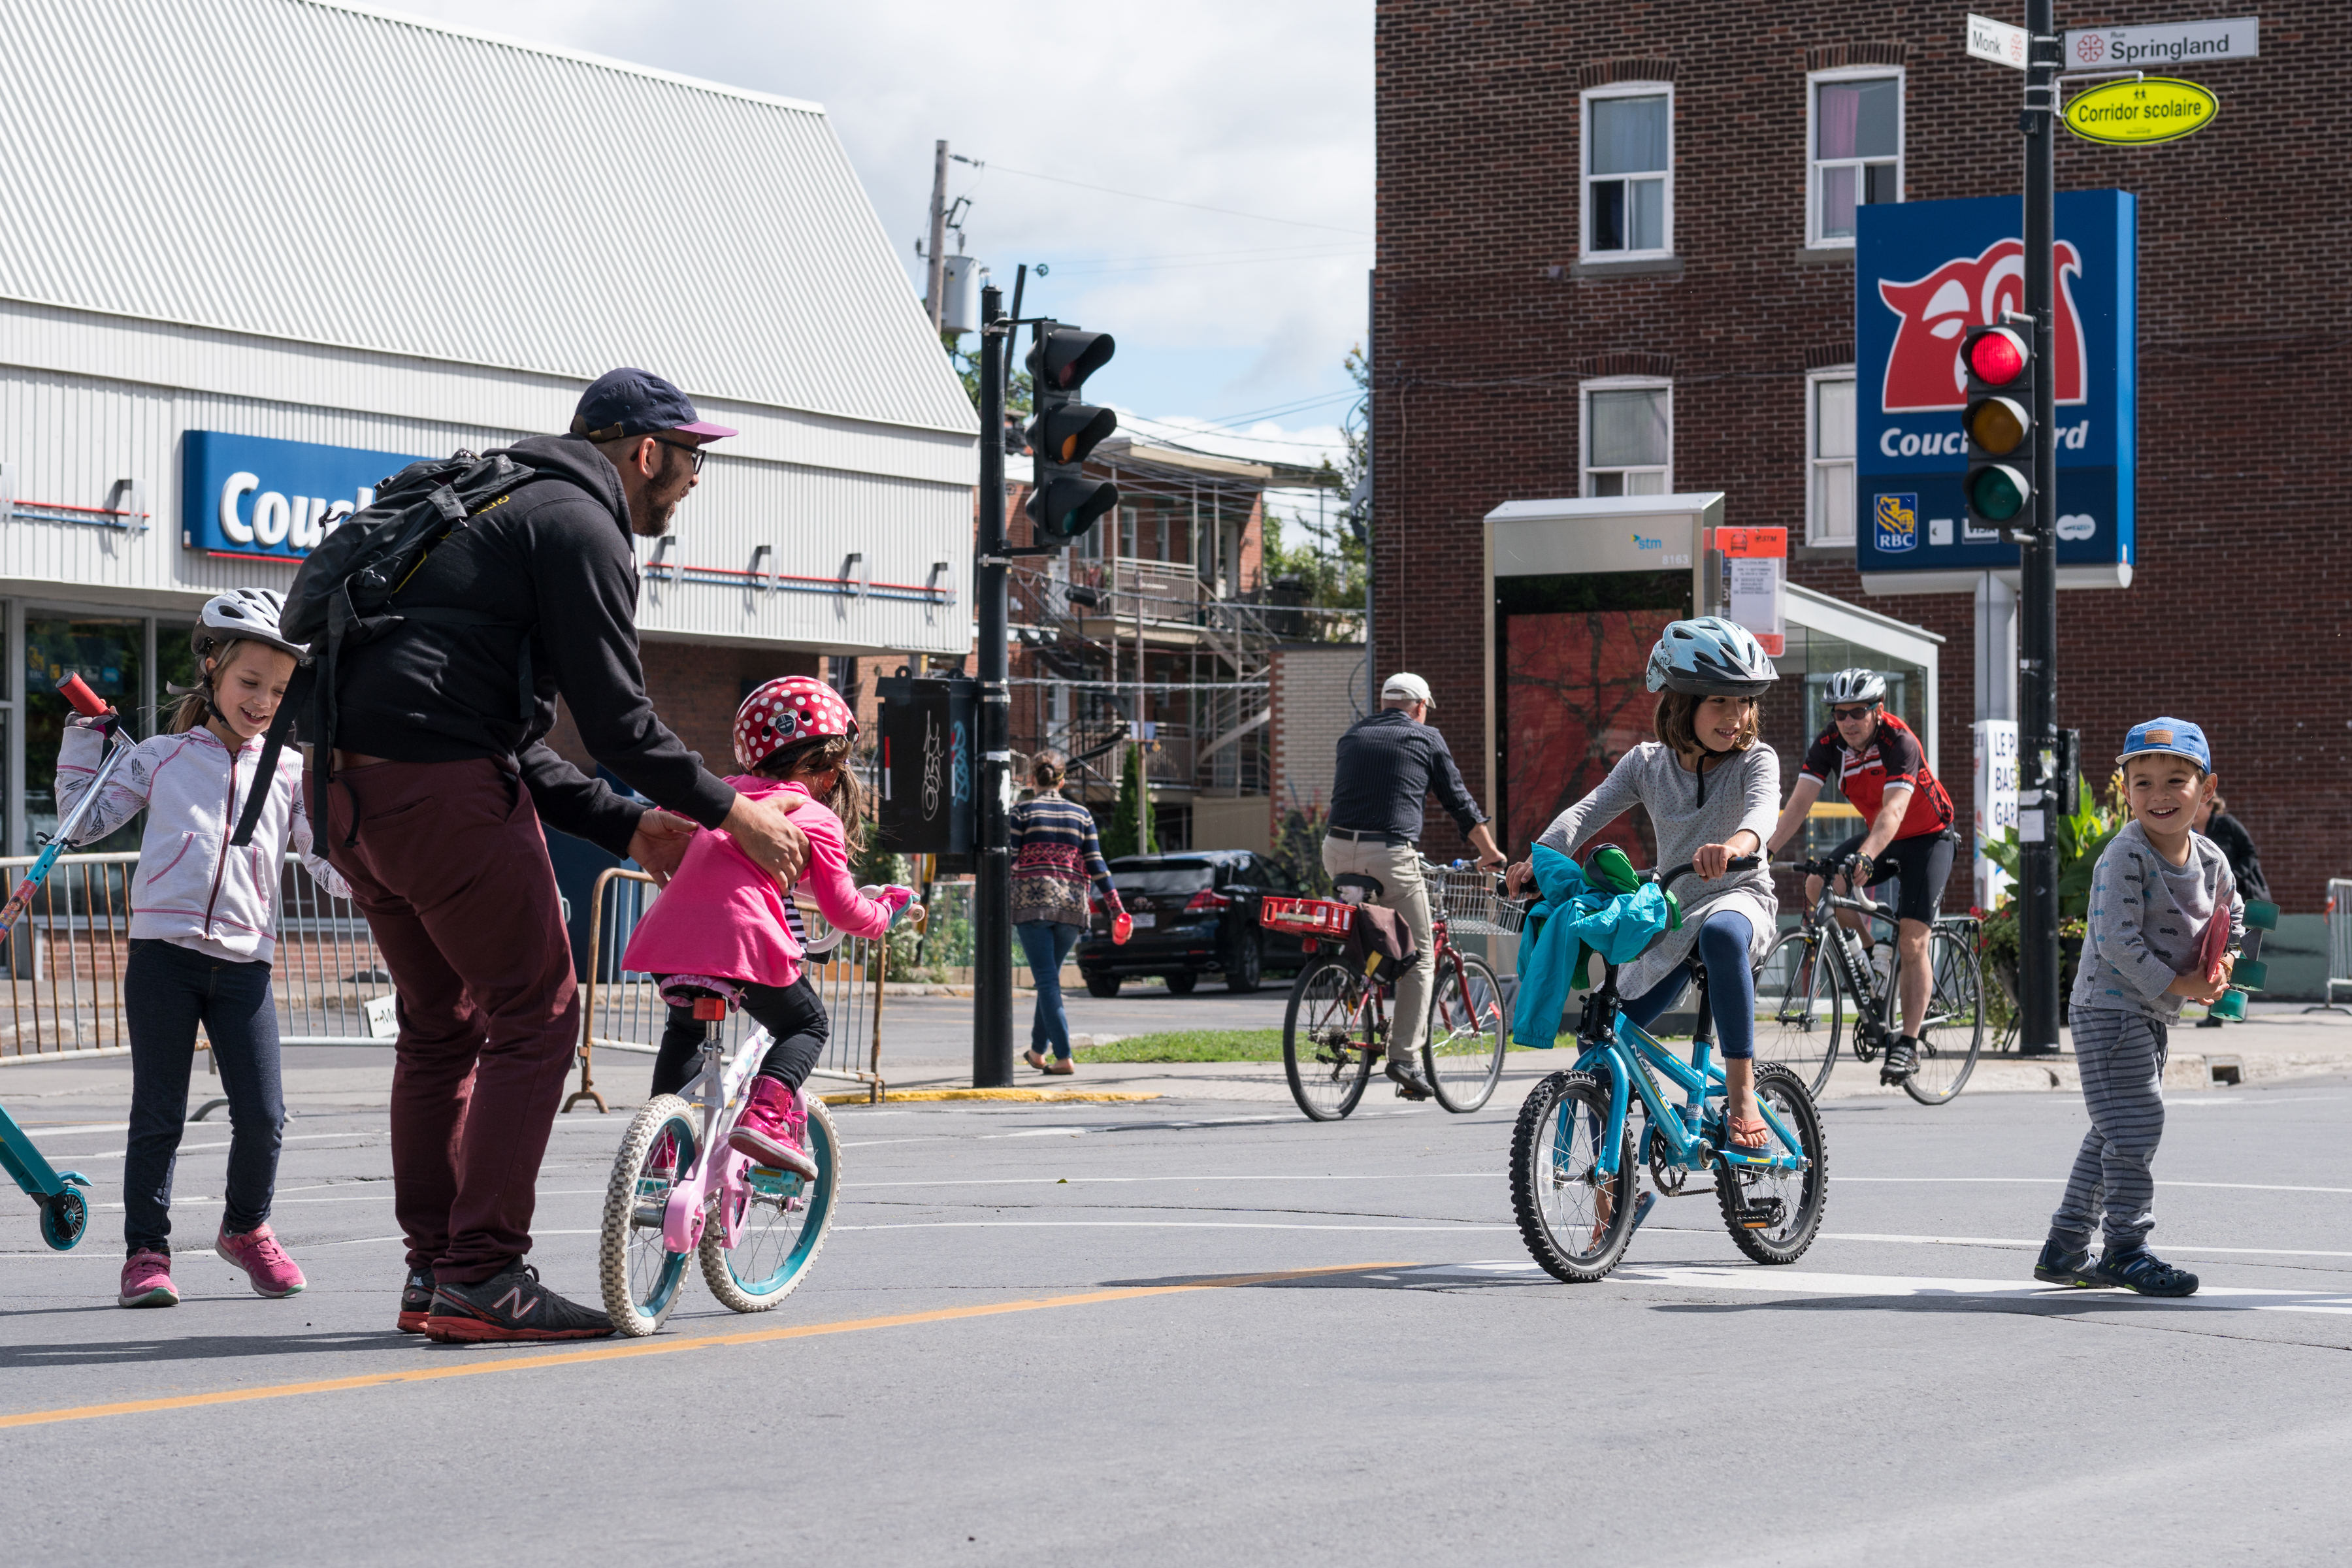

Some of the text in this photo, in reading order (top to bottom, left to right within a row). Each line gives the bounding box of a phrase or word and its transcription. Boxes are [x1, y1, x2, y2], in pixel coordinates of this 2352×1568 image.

[1973, 30, 2001, 55] Monk
[2111, 34, 2229, 63] Springland
[2078, 99, 2202, 122] Corridor scolaire
[1638, 538, 1662, 550] stm
[1880, 534, 1913, 547] RBC
[1662, 554, 1689, 565] 8163
[1995, 732, 2006, 757] LE
[1631, 1043, 1673, 1109] NORCO
